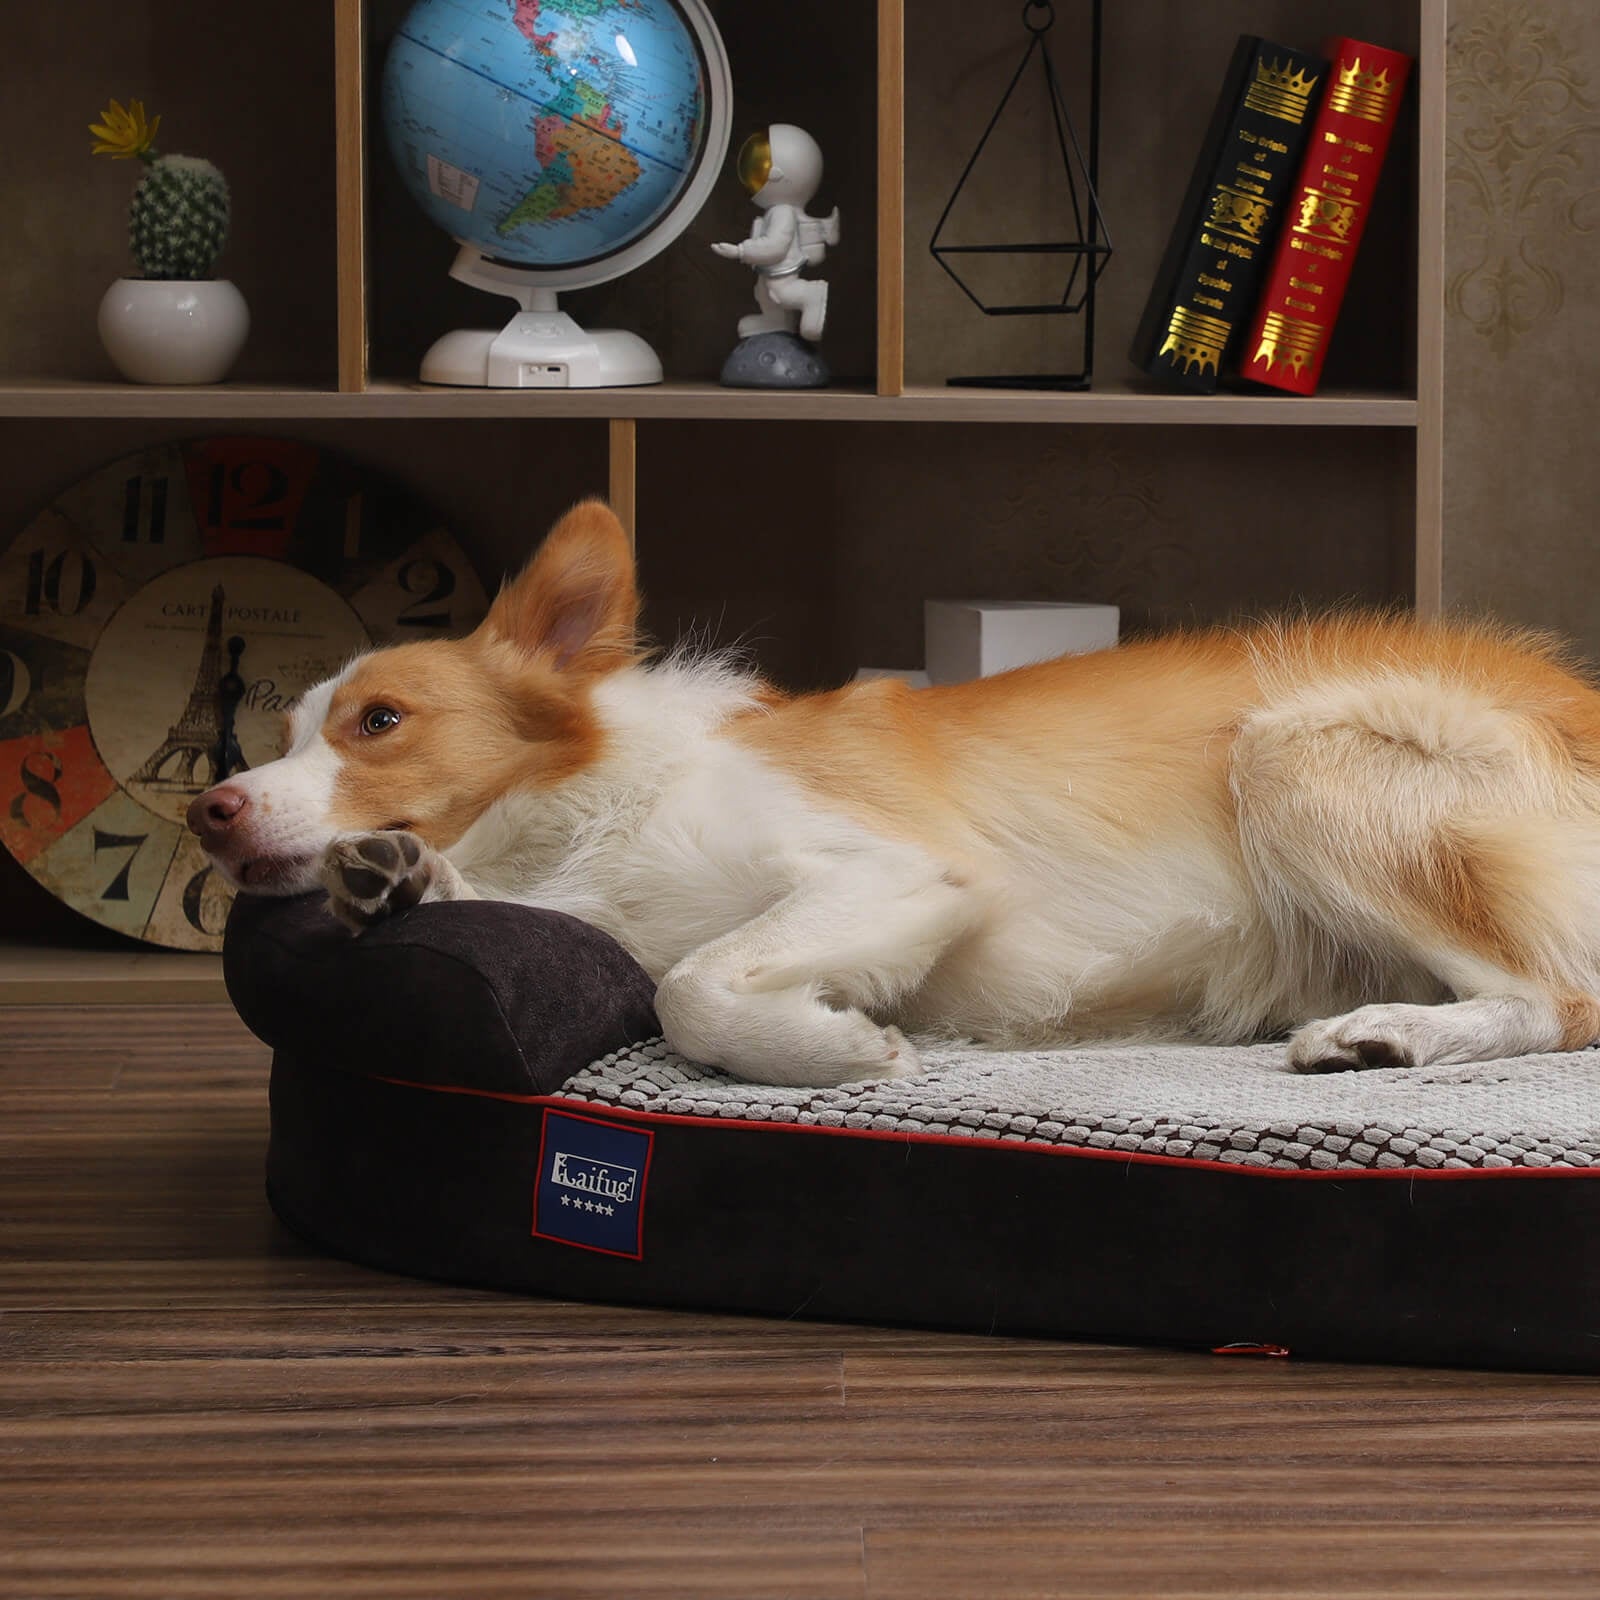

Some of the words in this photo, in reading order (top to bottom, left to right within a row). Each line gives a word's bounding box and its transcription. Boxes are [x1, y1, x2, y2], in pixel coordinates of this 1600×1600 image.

[122, 475, 168, 544] 11
[207, 461, 290, 530] 12
[344, 488, 364, 560] 1
[25, 547, 97, 616] 10
[161, 604, 207, 617] CART
[227, 607, 301, 623] POSTALE
[397, 560, 456, 627] 2
[10, 752, 63, 828] 8
[93, 830, 148, 901] 7
